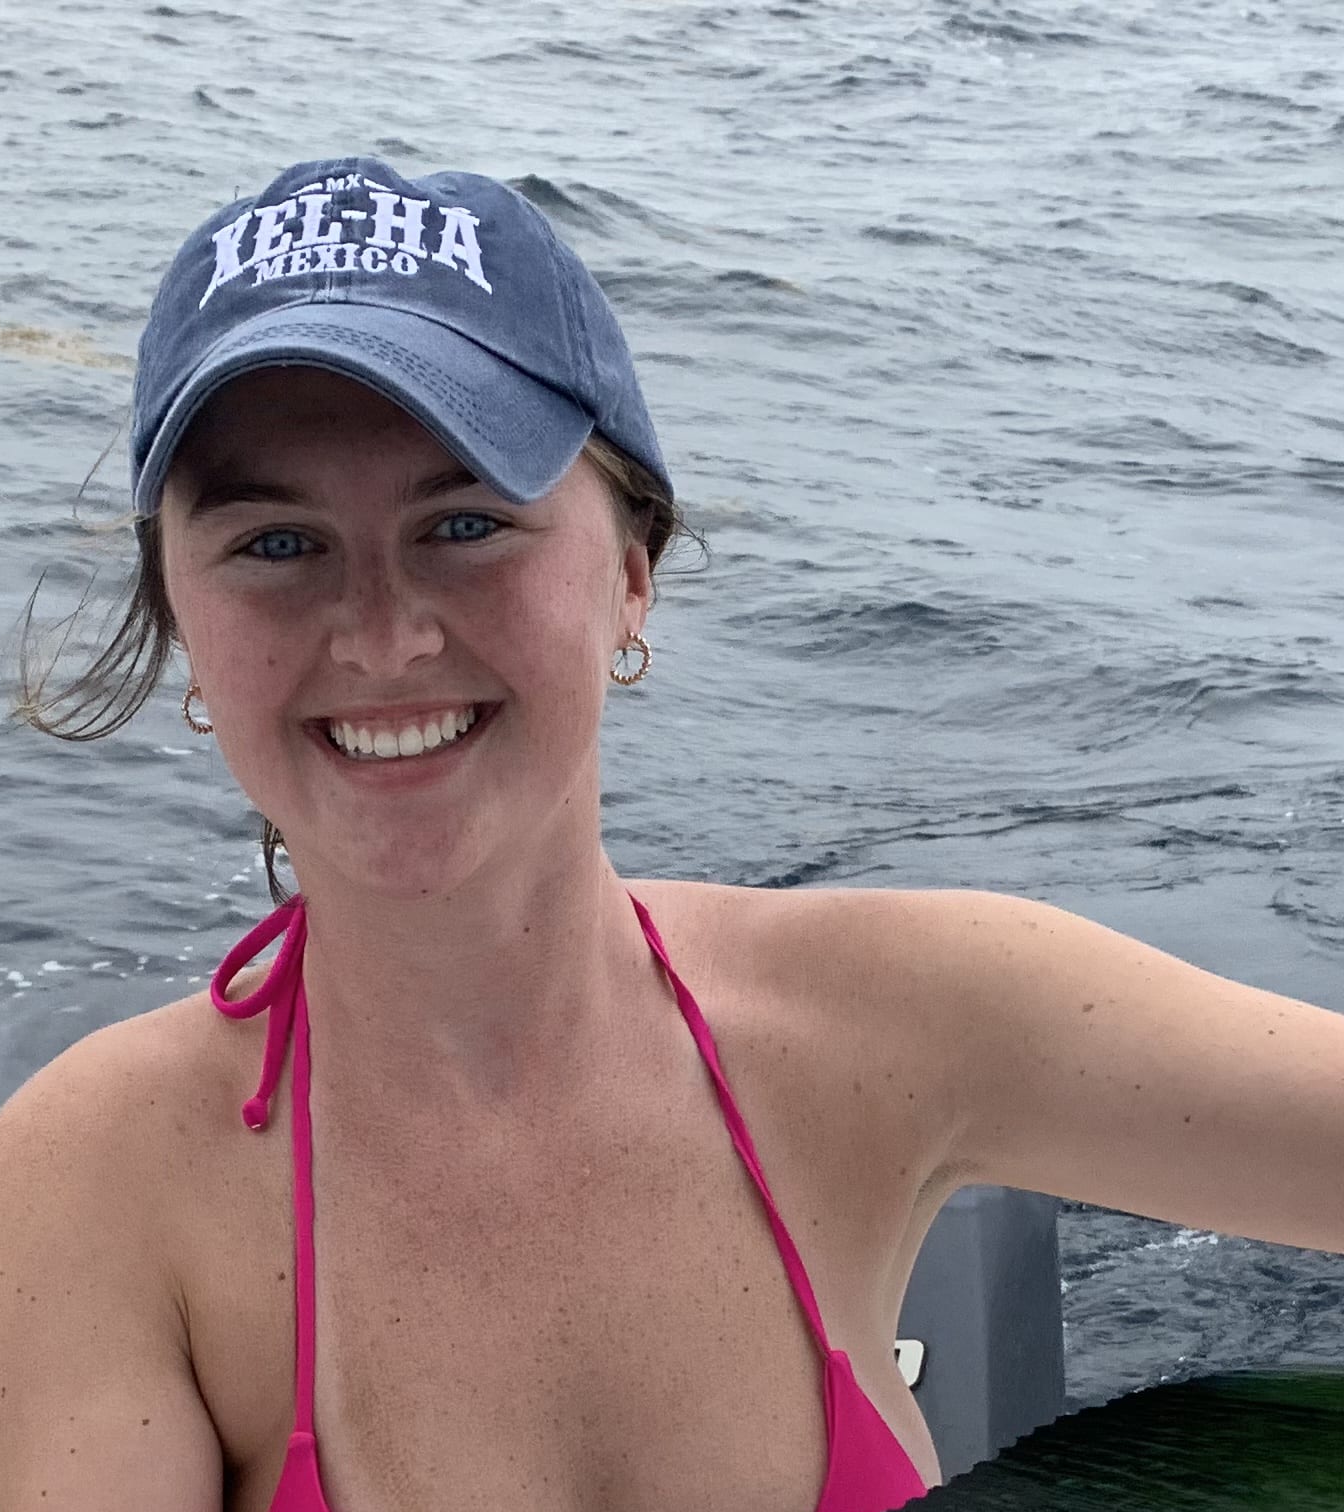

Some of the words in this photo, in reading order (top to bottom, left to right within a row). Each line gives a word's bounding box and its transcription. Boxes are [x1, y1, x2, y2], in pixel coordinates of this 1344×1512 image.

[325, 173, 362, 193] MX
[199, 191, 493, 311] XEL-HA
[251, 242, 421, 288] MEXICO
